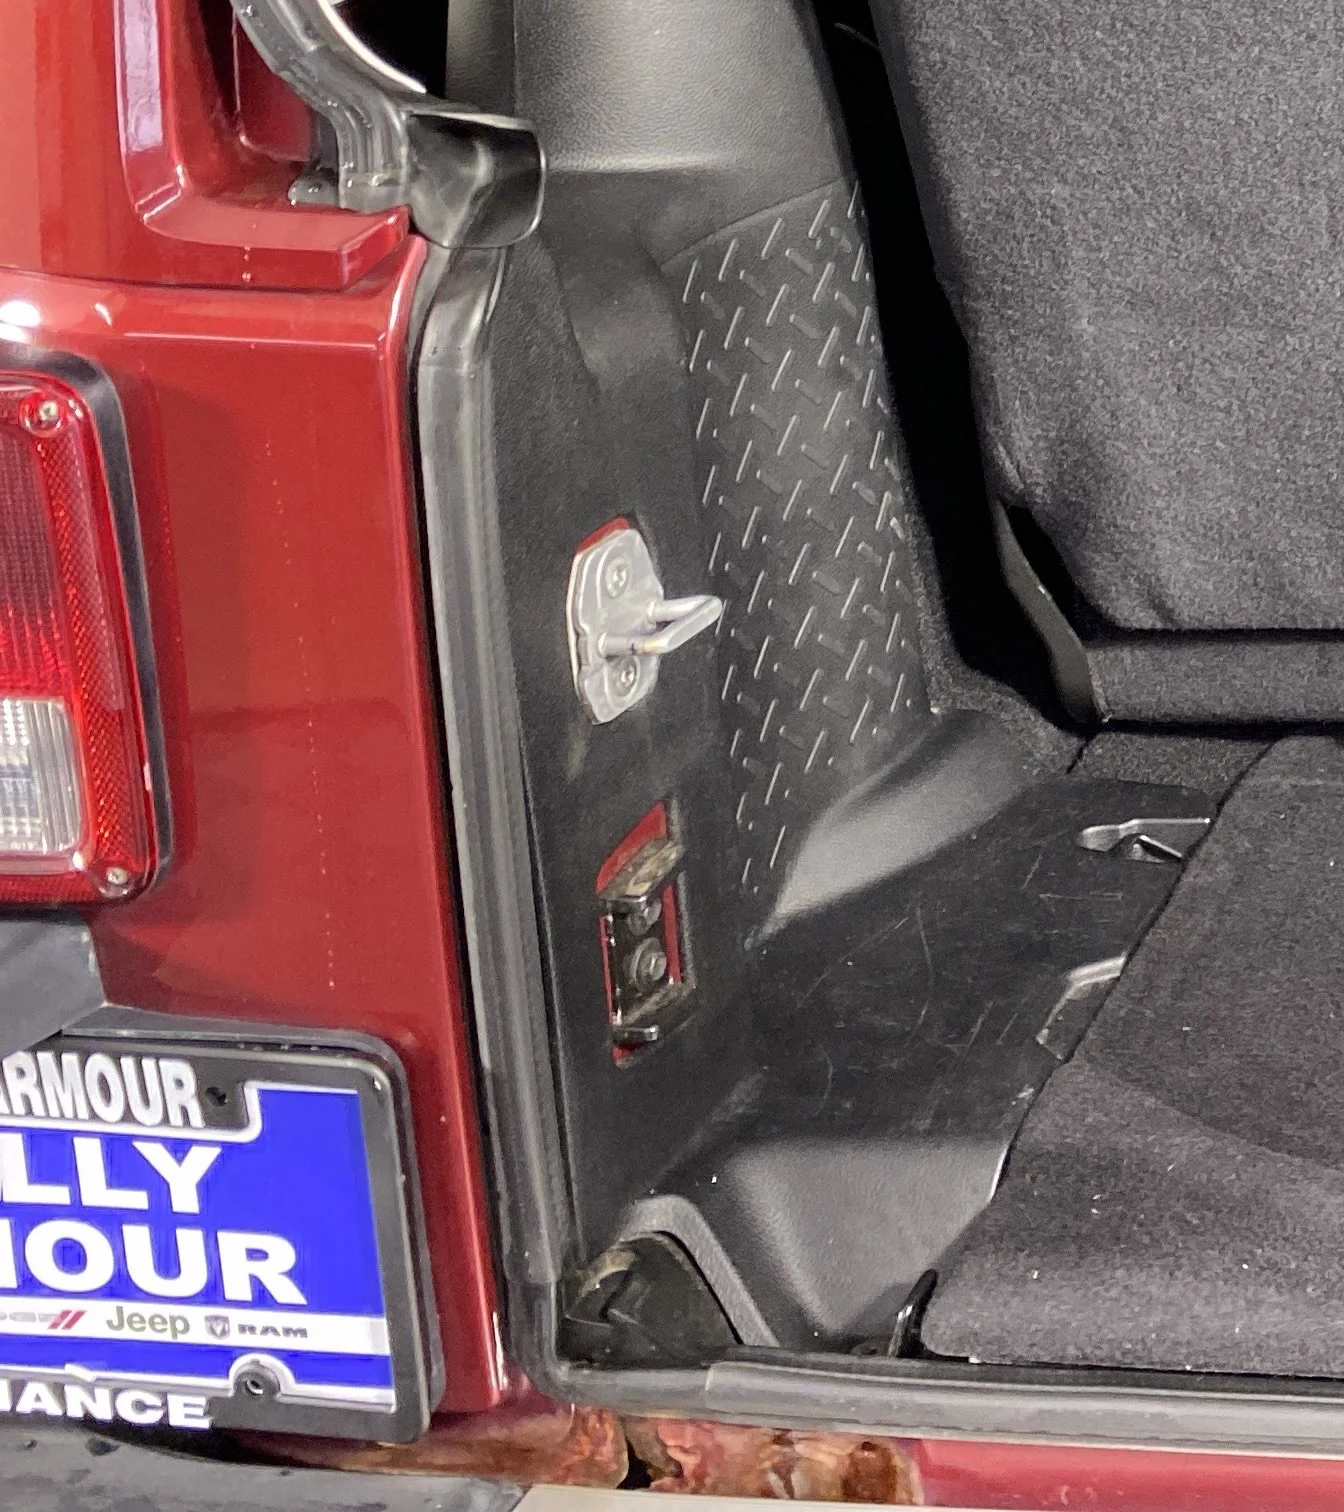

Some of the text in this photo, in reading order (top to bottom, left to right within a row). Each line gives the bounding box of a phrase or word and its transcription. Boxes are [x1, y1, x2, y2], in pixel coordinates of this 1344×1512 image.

[0, 1051, 206, 1128] RMOUR
[0, 1219, 308, 1305] OUR
[106, 1305, 309, 1341] Jeep RAM
[0, 1379, 212, 1430] ANCE
